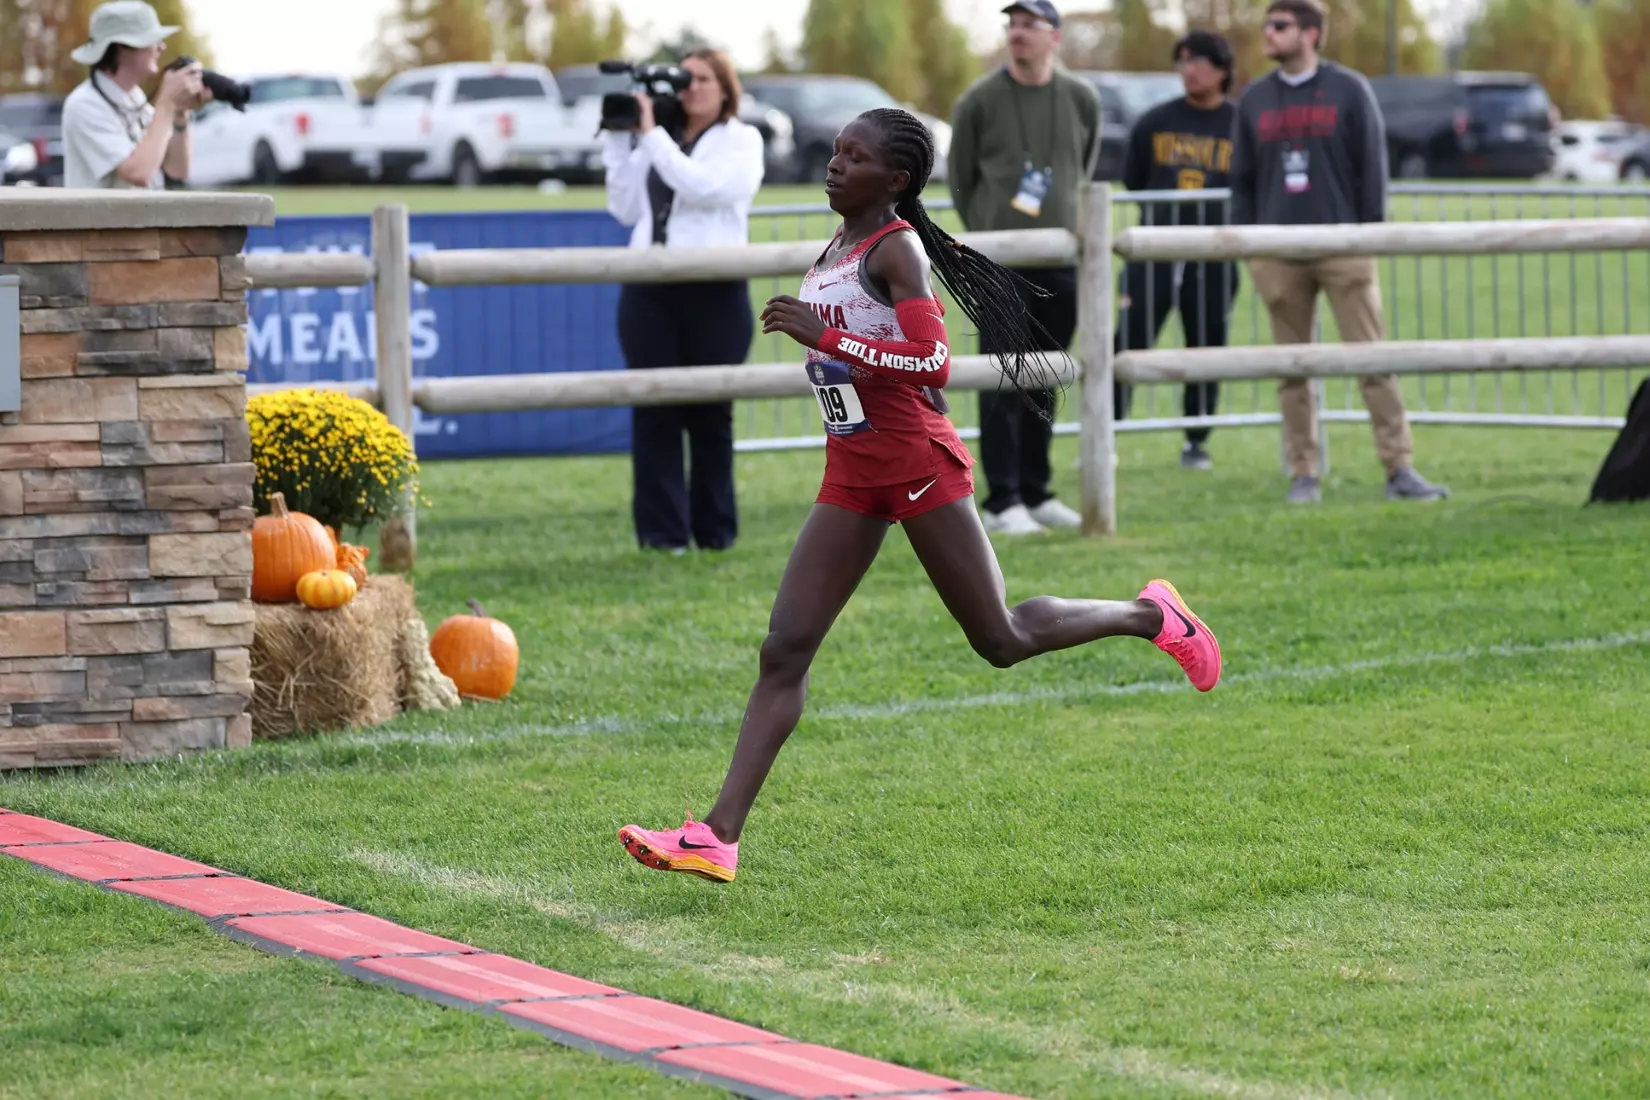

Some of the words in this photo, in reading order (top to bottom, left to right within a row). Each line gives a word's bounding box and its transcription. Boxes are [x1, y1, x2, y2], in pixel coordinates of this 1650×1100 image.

[837, 336, 879, 367] TIDE
[880, 340, 948, 372] CRIMSON
[816, 386, 848, 423] 09
